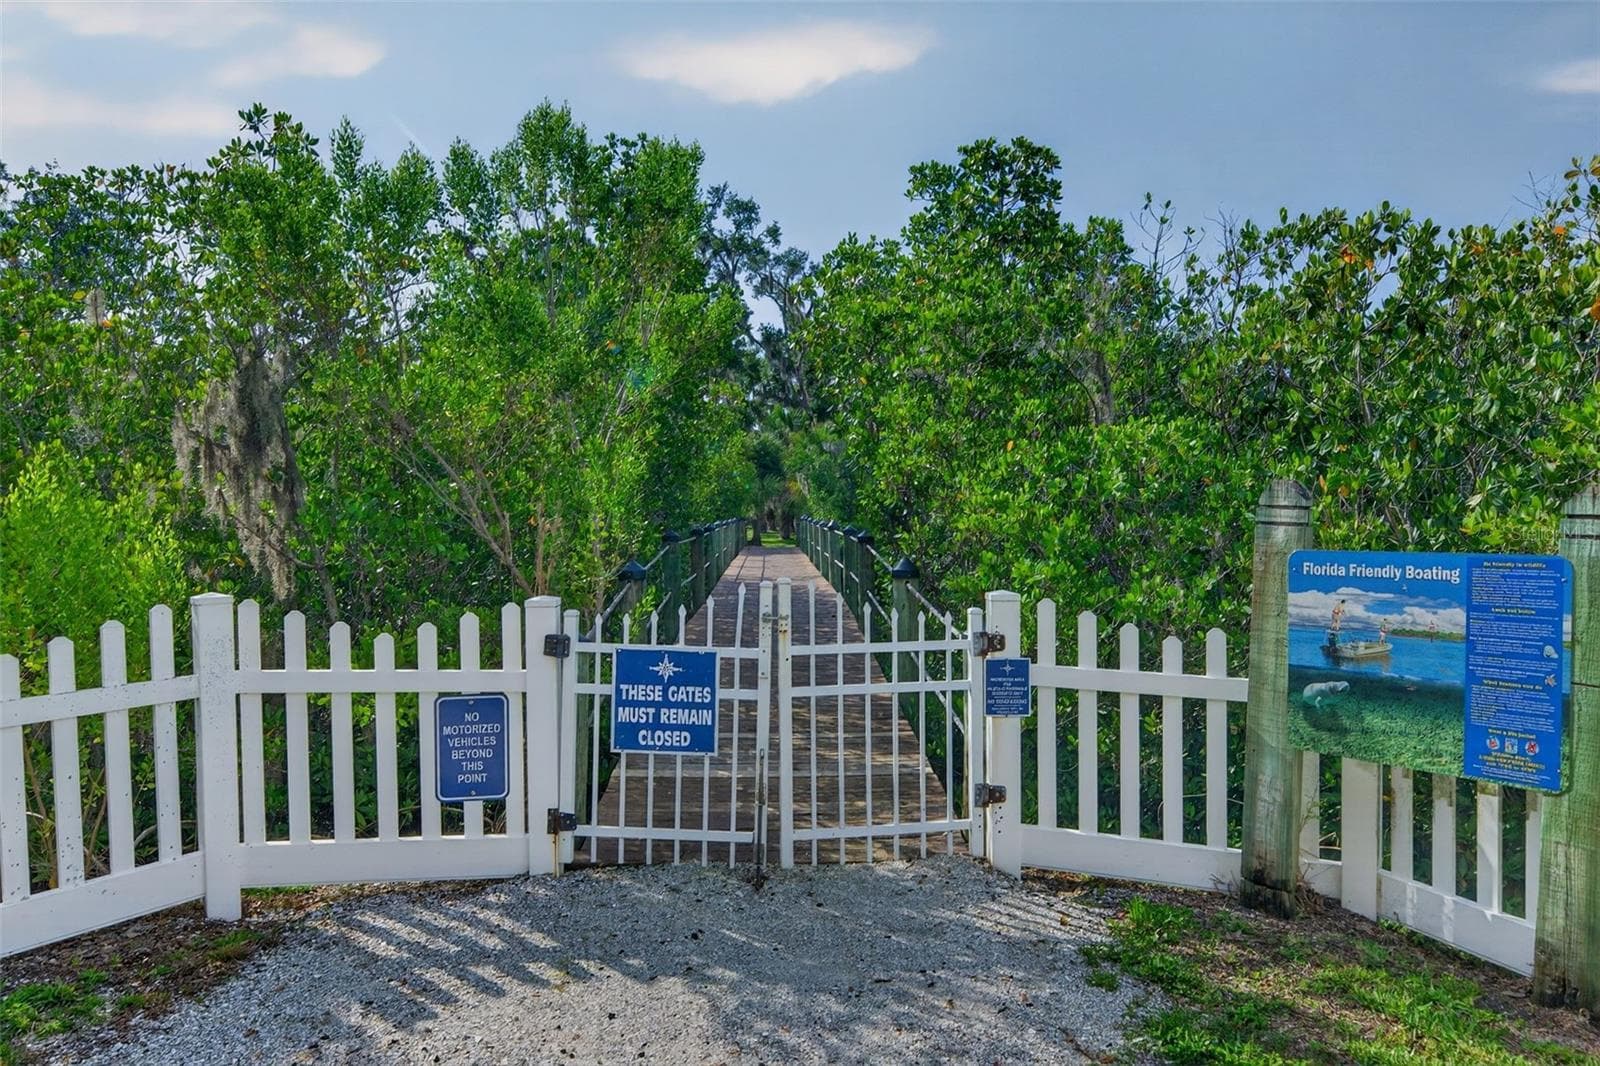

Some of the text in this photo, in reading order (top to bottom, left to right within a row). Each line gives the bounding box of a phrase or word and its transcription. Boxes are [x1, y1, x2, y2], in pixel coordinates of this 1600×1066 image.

[1303, 562, 1461, 585] Florida Friendly Boating
[619, 684, 712, 703] THESE GATES
[464, 712, 480, 722] NO
[617, 707, 713, 726] MUST REMAIN
[442, 723, 501, 736] MOTORIZED
[448, 736, 497, 748] VEHICLES
[638, 729, 692, 747] CLOSED
[451, 748, 494, 760] BEYOND
[461, 761, 484, 771] THIS
[457, 773, 488, 784] POINT
